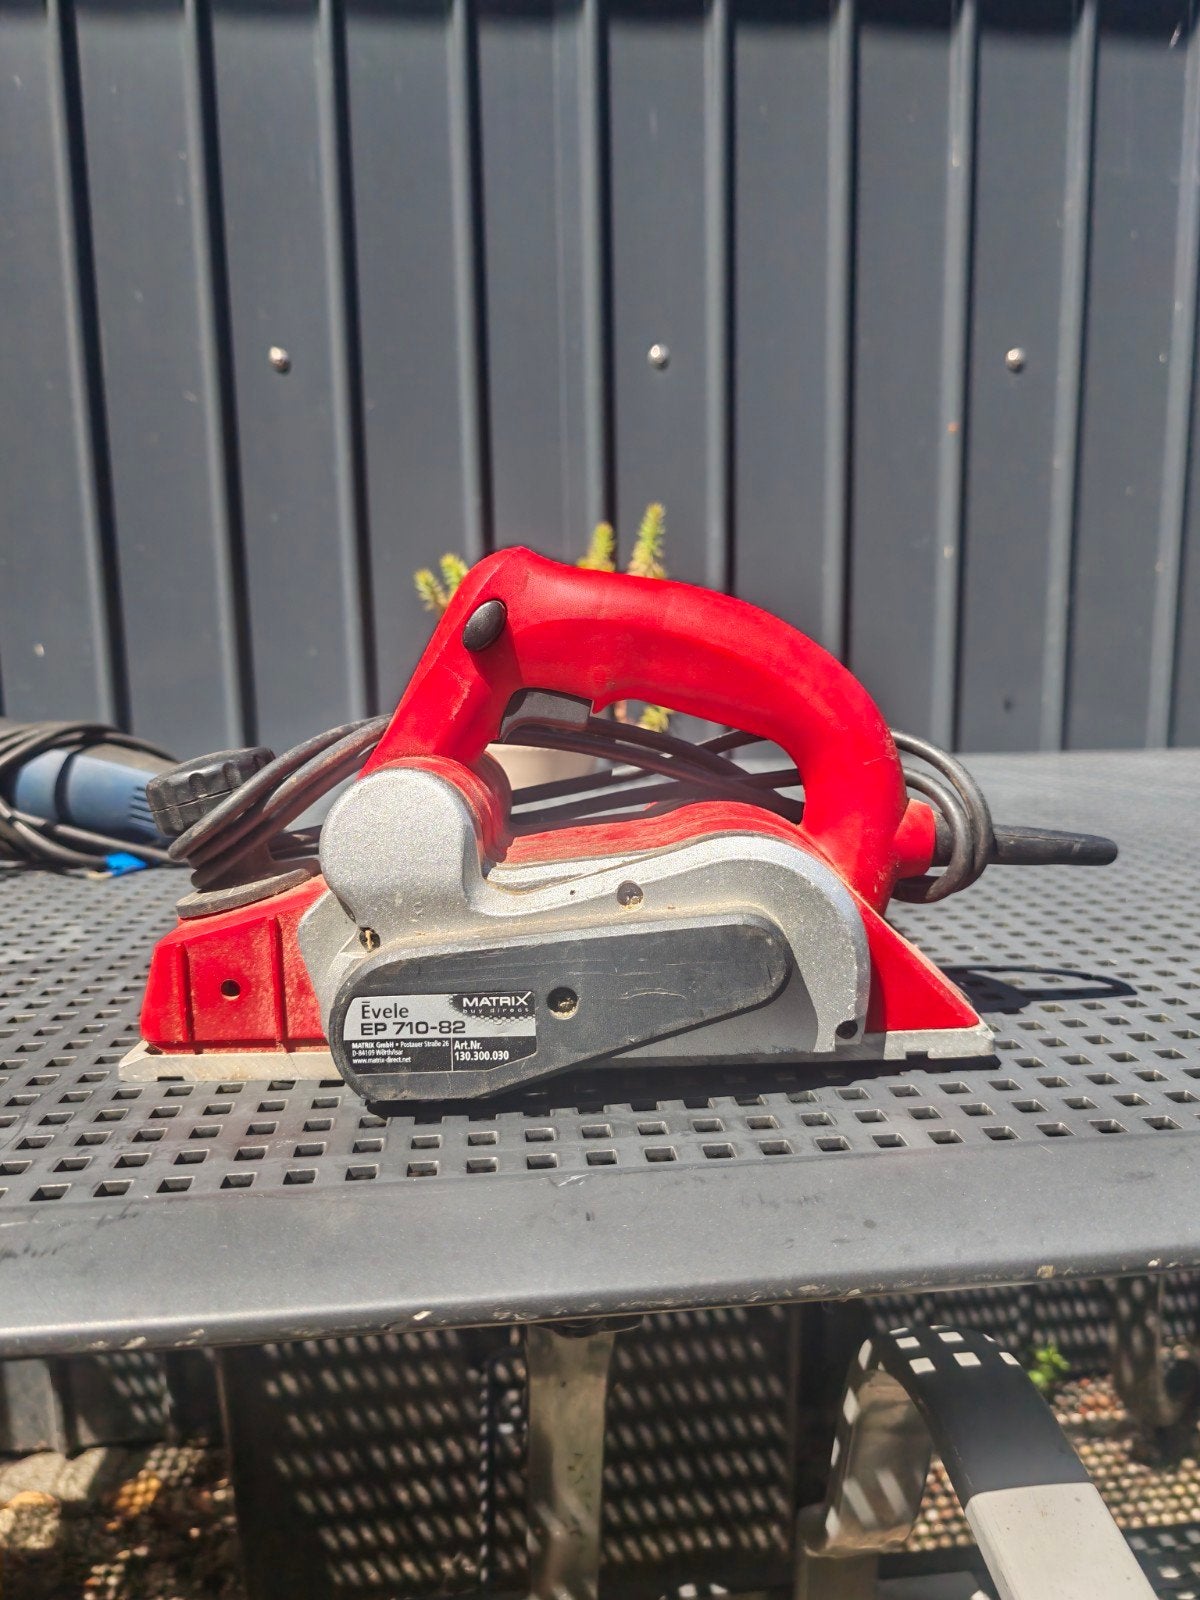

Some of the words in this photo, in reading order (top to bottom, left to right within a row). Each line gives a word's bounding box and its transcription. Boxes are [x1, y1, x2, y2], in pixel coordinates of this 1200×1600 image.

[462, 991, 532, 1007] MATRIX
[360, 1023, 387, 1036] EP
[392, 1020, 466, 1035] 710-82
[376, 1041, 394, 1049] GmbH
[454, 1050, 510, 1061] 130.300.030
